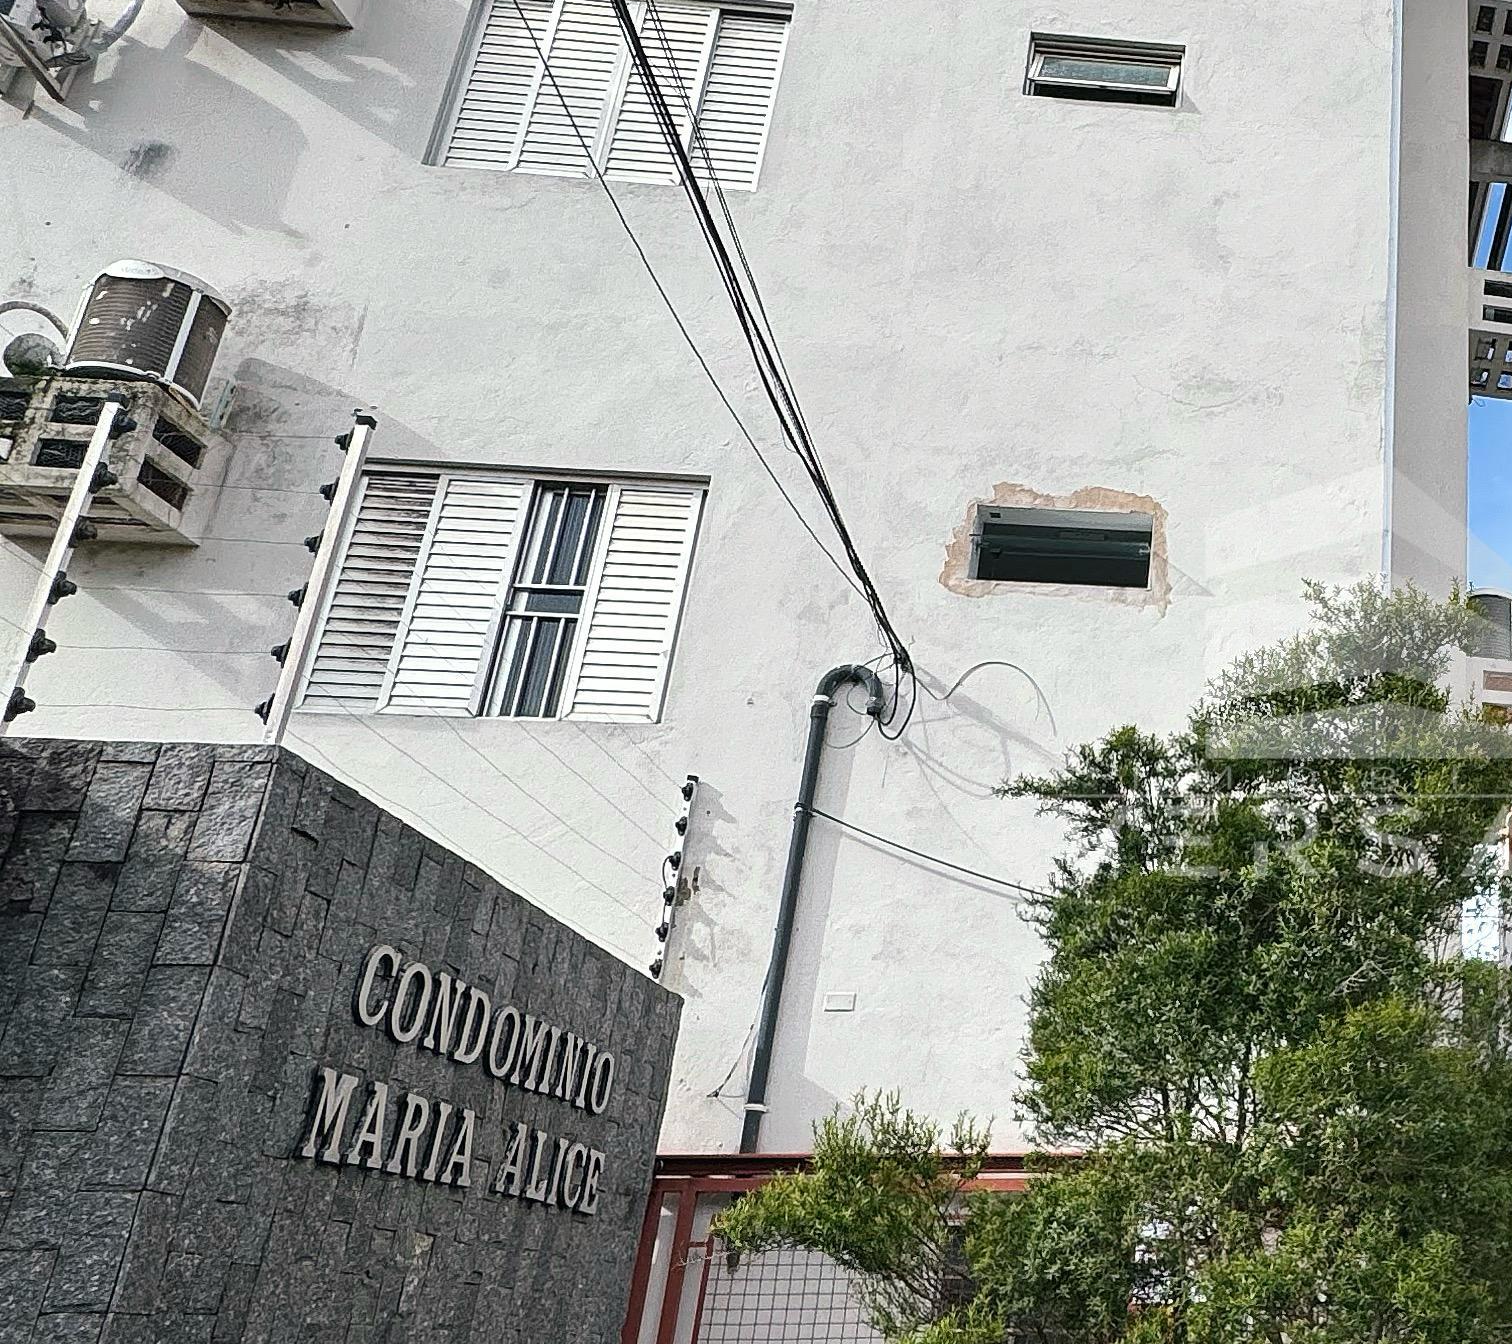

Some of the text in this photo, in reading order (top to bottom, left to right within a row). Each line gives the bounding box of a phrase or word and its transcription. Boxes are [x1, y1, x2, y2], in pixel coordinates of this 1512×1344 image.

[358, 943, 615, 1115] CONDOMINIO
[302, 1067, 606, 1216] MARIA ALICE
